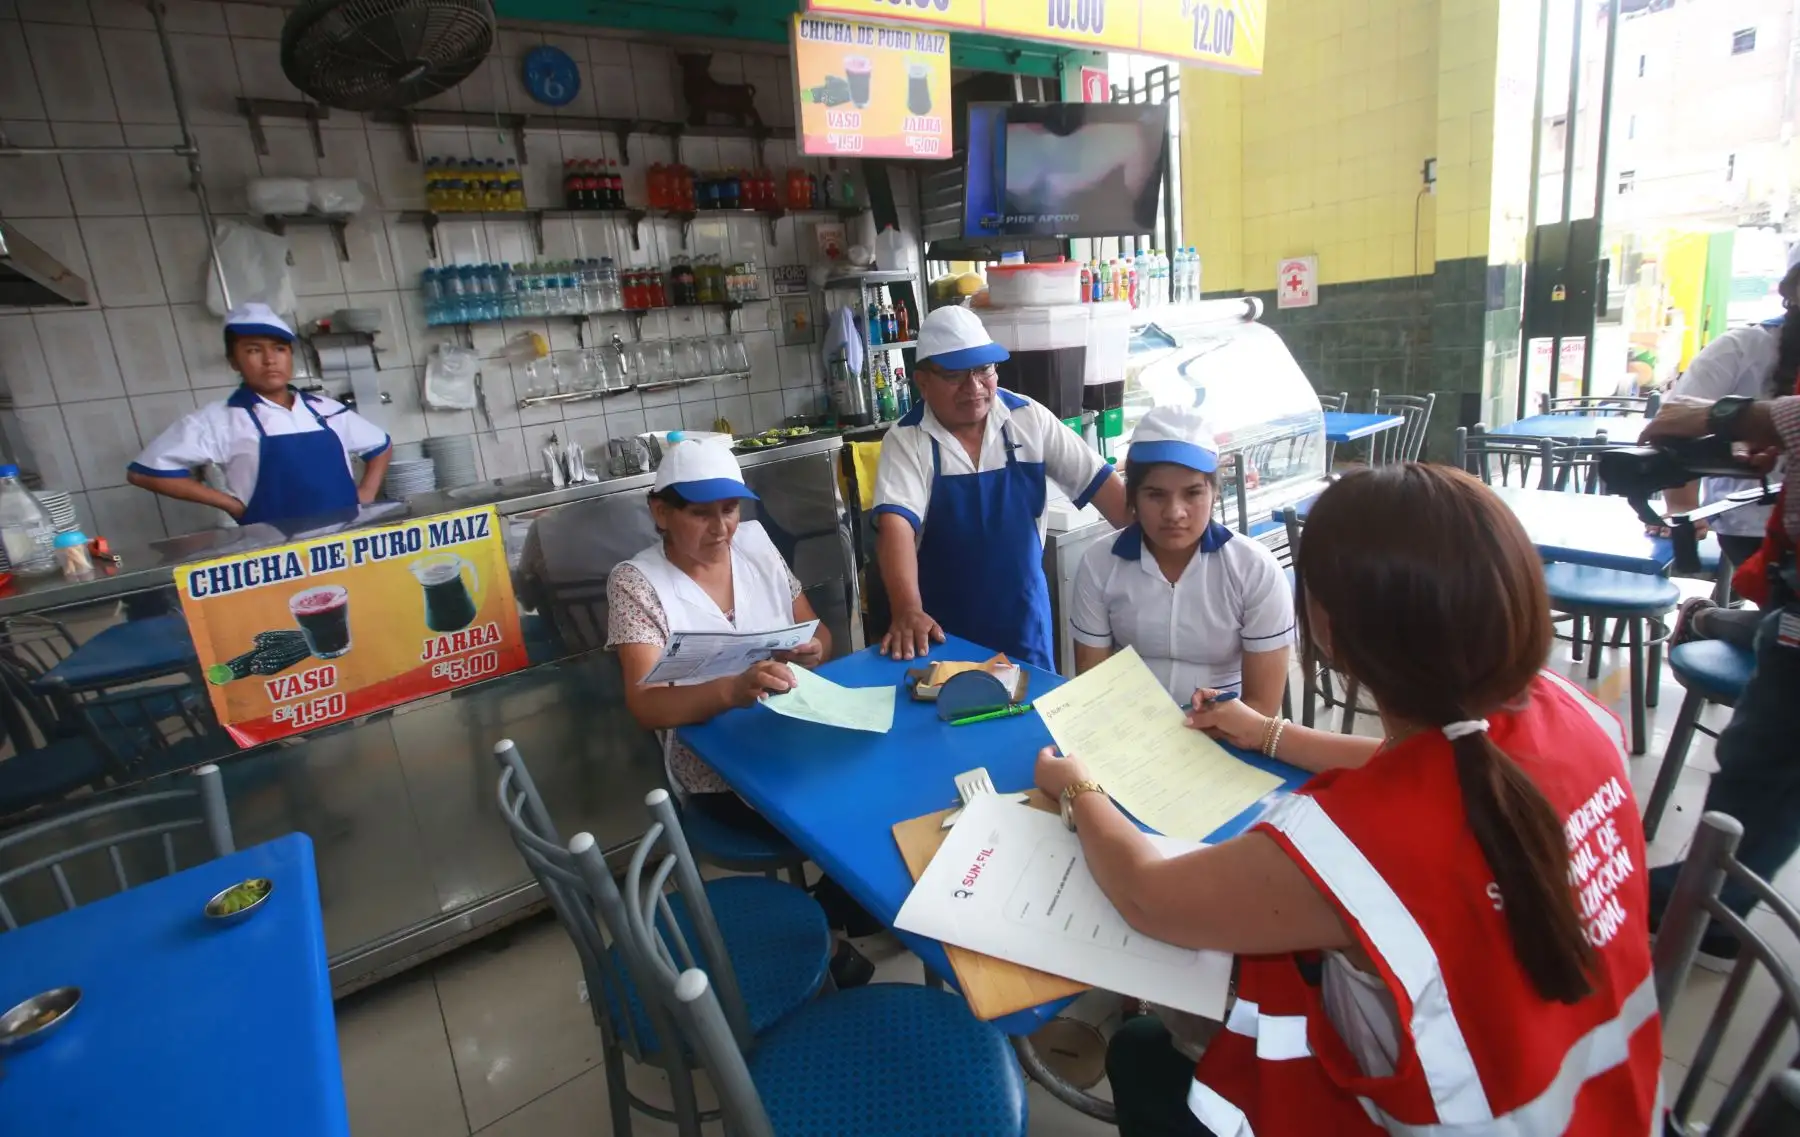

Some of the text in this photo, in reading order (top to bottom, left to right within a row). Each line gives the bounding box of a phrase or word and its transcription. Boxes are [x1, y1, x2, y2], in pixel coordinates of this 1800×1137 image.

[800, 19, 945, 54] CHICHA DE PURO MAIZ
[827, 112, 860, 128] VASO
[1006, 214, 1035, 224] PIDE
[1038, 213, 1080, 223] APOYO
[774, 266, 806, 280] AFORO
[189, 513, 489, 598] CHICHA DE PURO MAIZ
[422, 623, 500, 660] JARRA
[266, 666, 335, 701] VASO
[1596, 818, 1622, 857] DE
